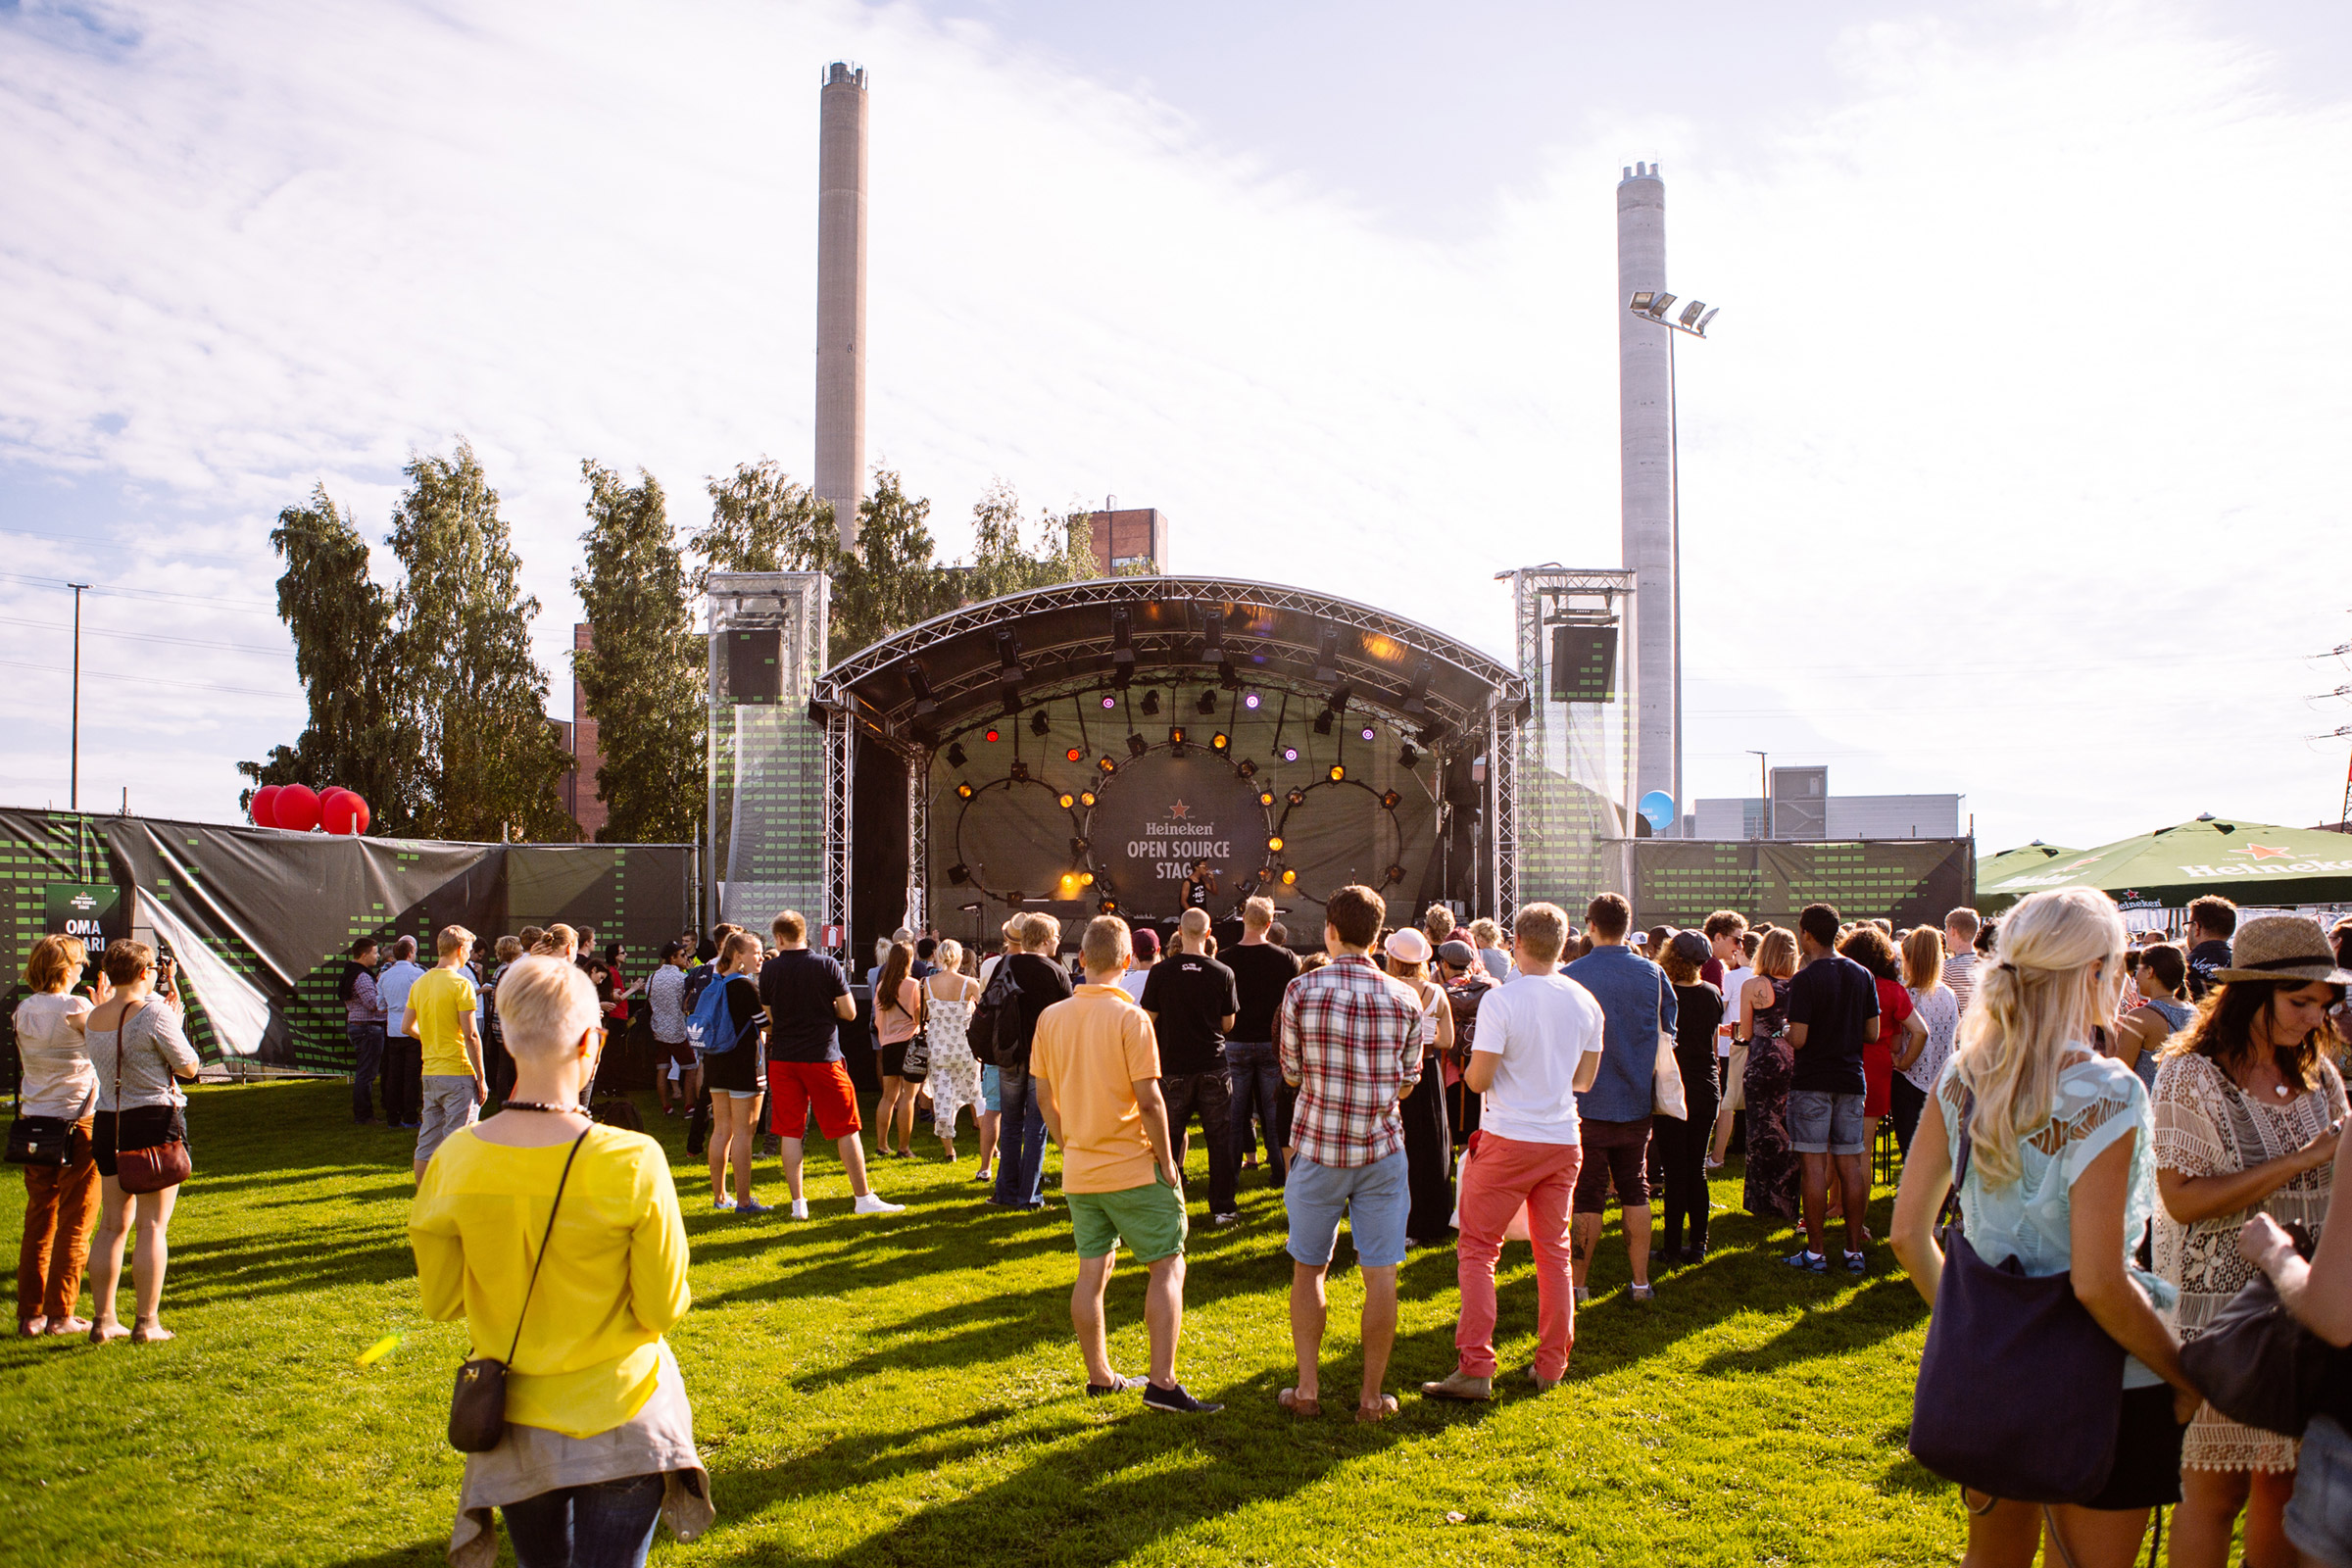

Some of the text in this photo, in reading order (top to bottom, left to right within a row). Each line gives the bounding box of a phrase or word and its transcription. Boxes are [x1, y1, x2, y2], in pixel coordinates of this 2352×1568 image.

[1146, 822, 1213, 835] Heineken
[1127, 841, 1230, 858] OPEN SOURCE
[1156, 862, 1193, 879] STAG
[2116, 900, 2162, 909] eineken
[65, 919, 101, 935] OMA
[82, 937, 106, 952] ARI
